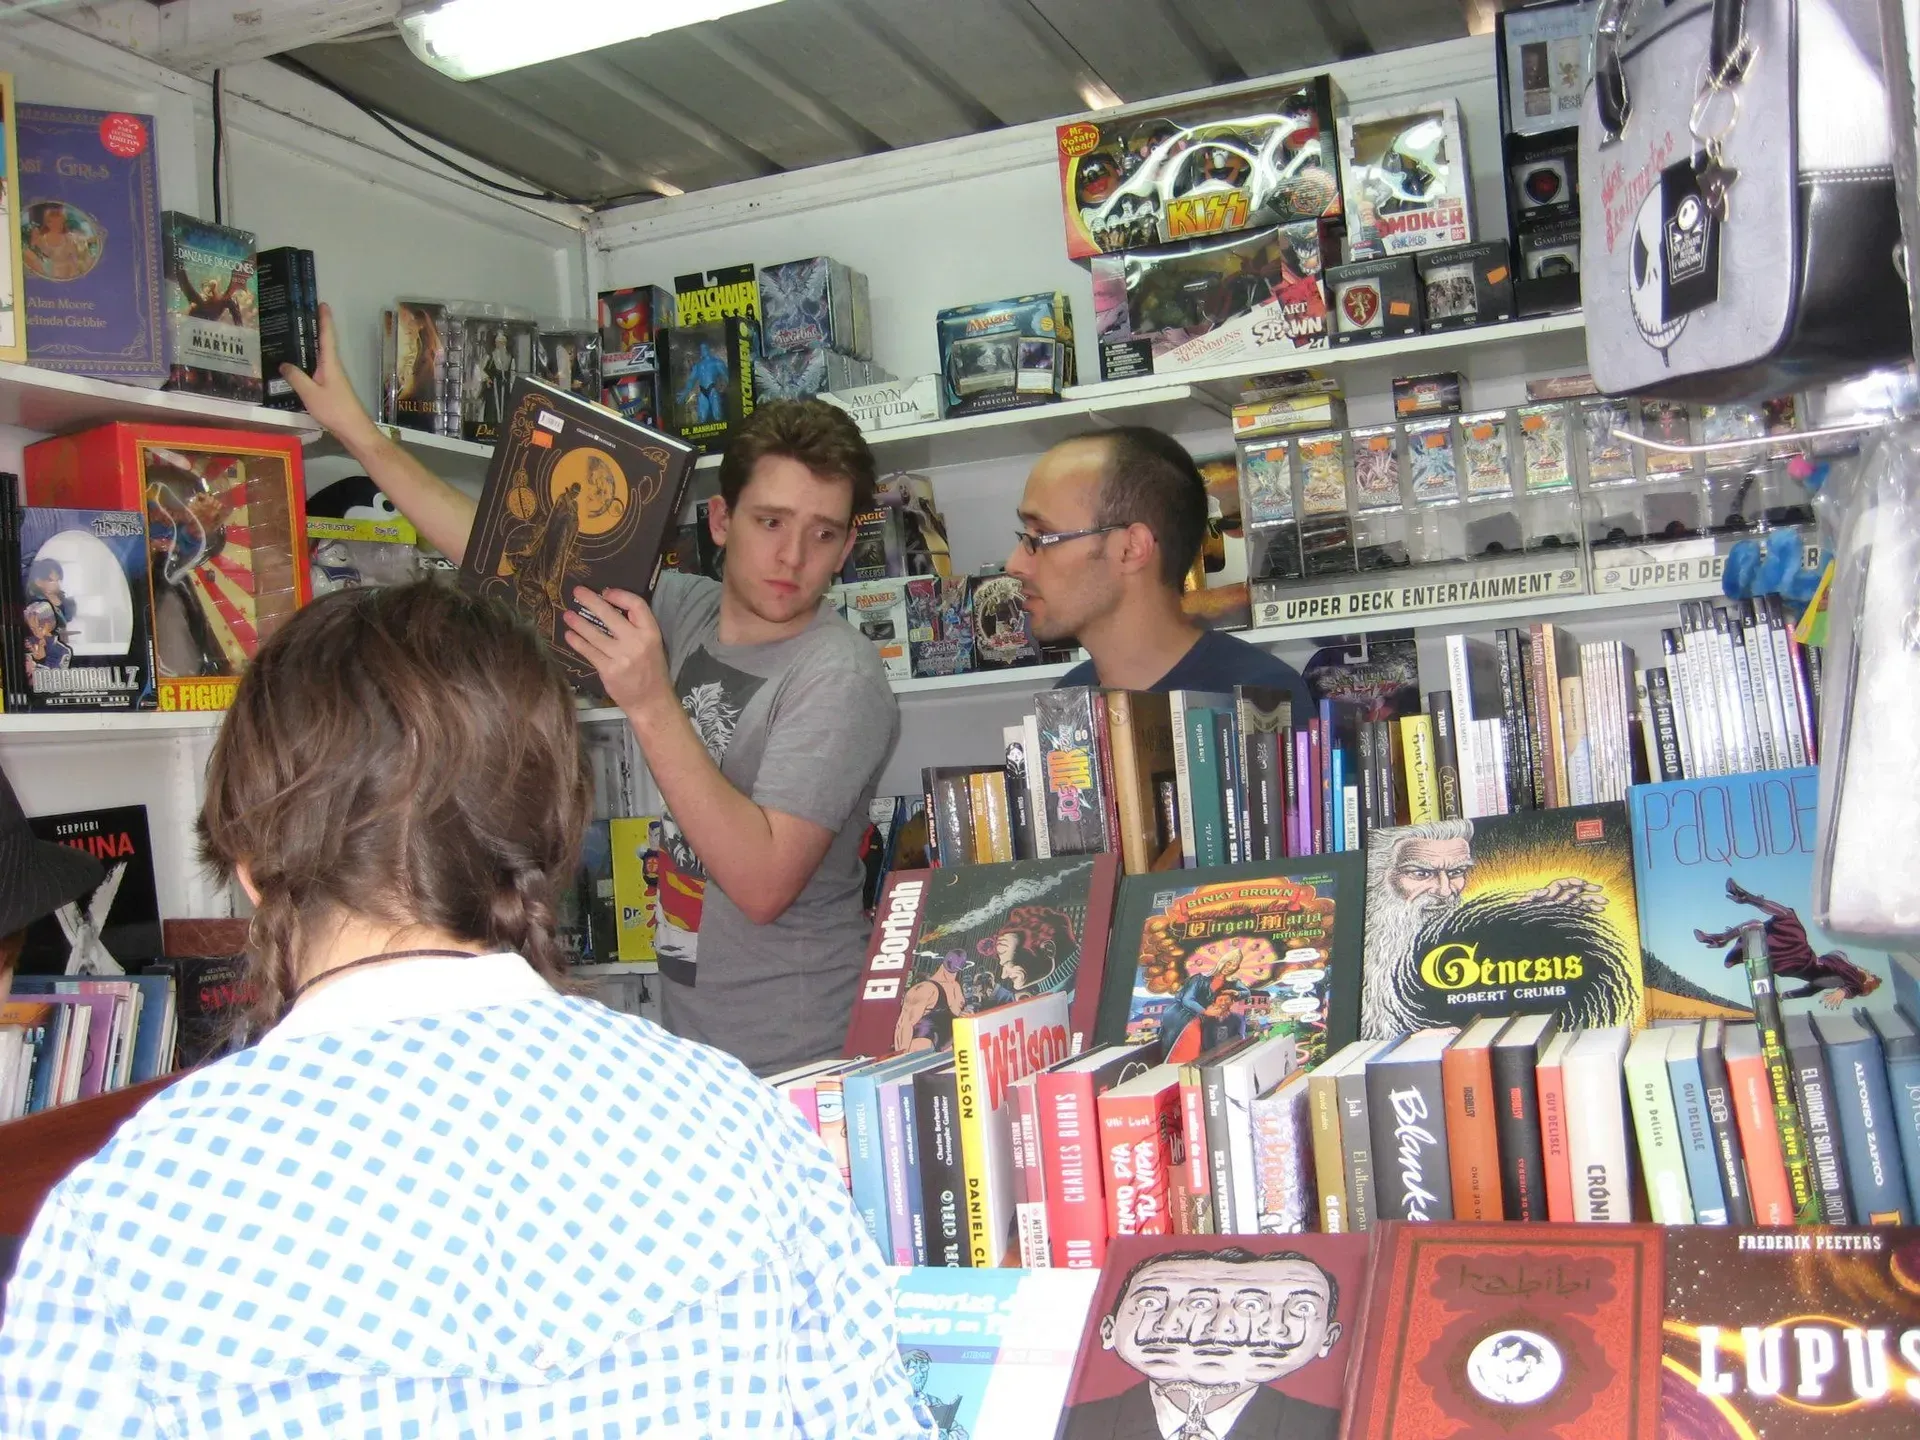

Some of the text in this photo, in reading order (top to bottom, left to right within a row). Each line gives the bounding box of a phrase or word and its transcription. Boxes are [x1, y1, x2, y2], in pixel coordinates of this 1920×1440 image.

[1061, 132, 1096, 147] Potato
[1066, 139, 1094, 155] Head
[1166, 191, 1249, 239] KISS
[1375, 207, 1464, 238] SMOKER
[177, 247, 203, 263] DANZA
[214, 256, 255, 275] DRAGONES
[27, 297, 95, 311] Alan Moore
[676, 281, 758, 315] WATCHMEN
[1281, 301, 1308, 314] ART
[25, 314, 107, 330] elinda Gebbie
[1252, 317, 1323, 347] SPAWN
[192, 335, 245, 356] MARTIN
[398, 400, 418, 412] KILL
[849, 400, 919, 421] STITUIDA
[851, 389, 903, 408] AVACYN
[1629, 562, 1690, 587] UPPER
[1286, 571, 1553, 620] UPPER DECK ENTERTAINMENT
[1652, 677, 1666, 687] 15
[1173, 711, 1185, 741] ETIENNE
[1436, 710, 1447, 737] TARDI
[1656, 706, 1679, 773] FIN DE SIGLO
[1049, 746, 1093, 822] JOE BAR
[56, 820, 100, 836] SERPIERI
[1225, 788, 1237, 840] LEJANOS
[623, 905, 642, 921] Dr.
[1186, 886, 1295, 909] BINKY BROWN
[862, 880, 925, 1001] El Borbah
[1183, 918, 1256, 940] Virgen
[1271, 931, 1296, 940] JUSTIN
[1446, 985, 1567, 1004] ROBERT CRUMB
[1764, 1029, 1783, 1059] Neil
[978, 1017, 1069, 1112] Wilson
[1800, 1067, 1819, 1082] EL
[1770, 1064, 1789, 1108] Gaiman
[1344, 1097, 1363, 1118] Jali
[1643, 1082, 1665, 1147] Guy Delisle
[1682, 1082, 1706, 1152] GUY DELISLE
[1706, 1086, 1729, 1123] RG
[1803, 1082, 1829, 1134] GOURMET
[856, 1103, 869, 1159] NATE POWELL
[931, 1095, 944, 1161] Charles Berberian
[941, 1095, 953, 1166] Christophe Gaultier
[1545, 1092, 1561, 1156] GUY DELISLE
[1852, 1061, 1885, 1187] ALFONSO ZAPICO
[957, 1049, 974, 1119] WILSON
[968, 1177, 983, 1241] DANIEL
[1011, 1121, 1024, 1169] JAMES STURM
[1021, 1113, 1037, 1168] JAMES STURM
[1055, 1092, 1086, 1203] CHARLES BURNS
[1388, 1083, 1440, 1222] Blanke
[1783, 1126, 1798, 1156] Dave
[1133, 1139, 1156, 1190] VIDA
[1213, 1149, 1226, 1168] EL
[1352, 1150, 1367, 1163] El
[1812, 1135, 1840, 1191] SOLITARIO
[1585, 1163, 1611, 1222] CRÓNI
[1824, 1192, 1846, 1216] JIRO
[939, 1189, 958, 1239] CIELO
[1354, 1206, 1368, 1231] gran
[912, 1213, 924, 1247] BRAIN
[1031, 1218, 1045, 1261] DEL GOLEM
[1738, 1234, 1882, 1251] FREDERIK PEETERS
[1065, 1239, 1093, 1268] GRO
[1457, 1263, 1592, 1299] habibi
[1696, 1325, 1920, 1399] LUPUS
